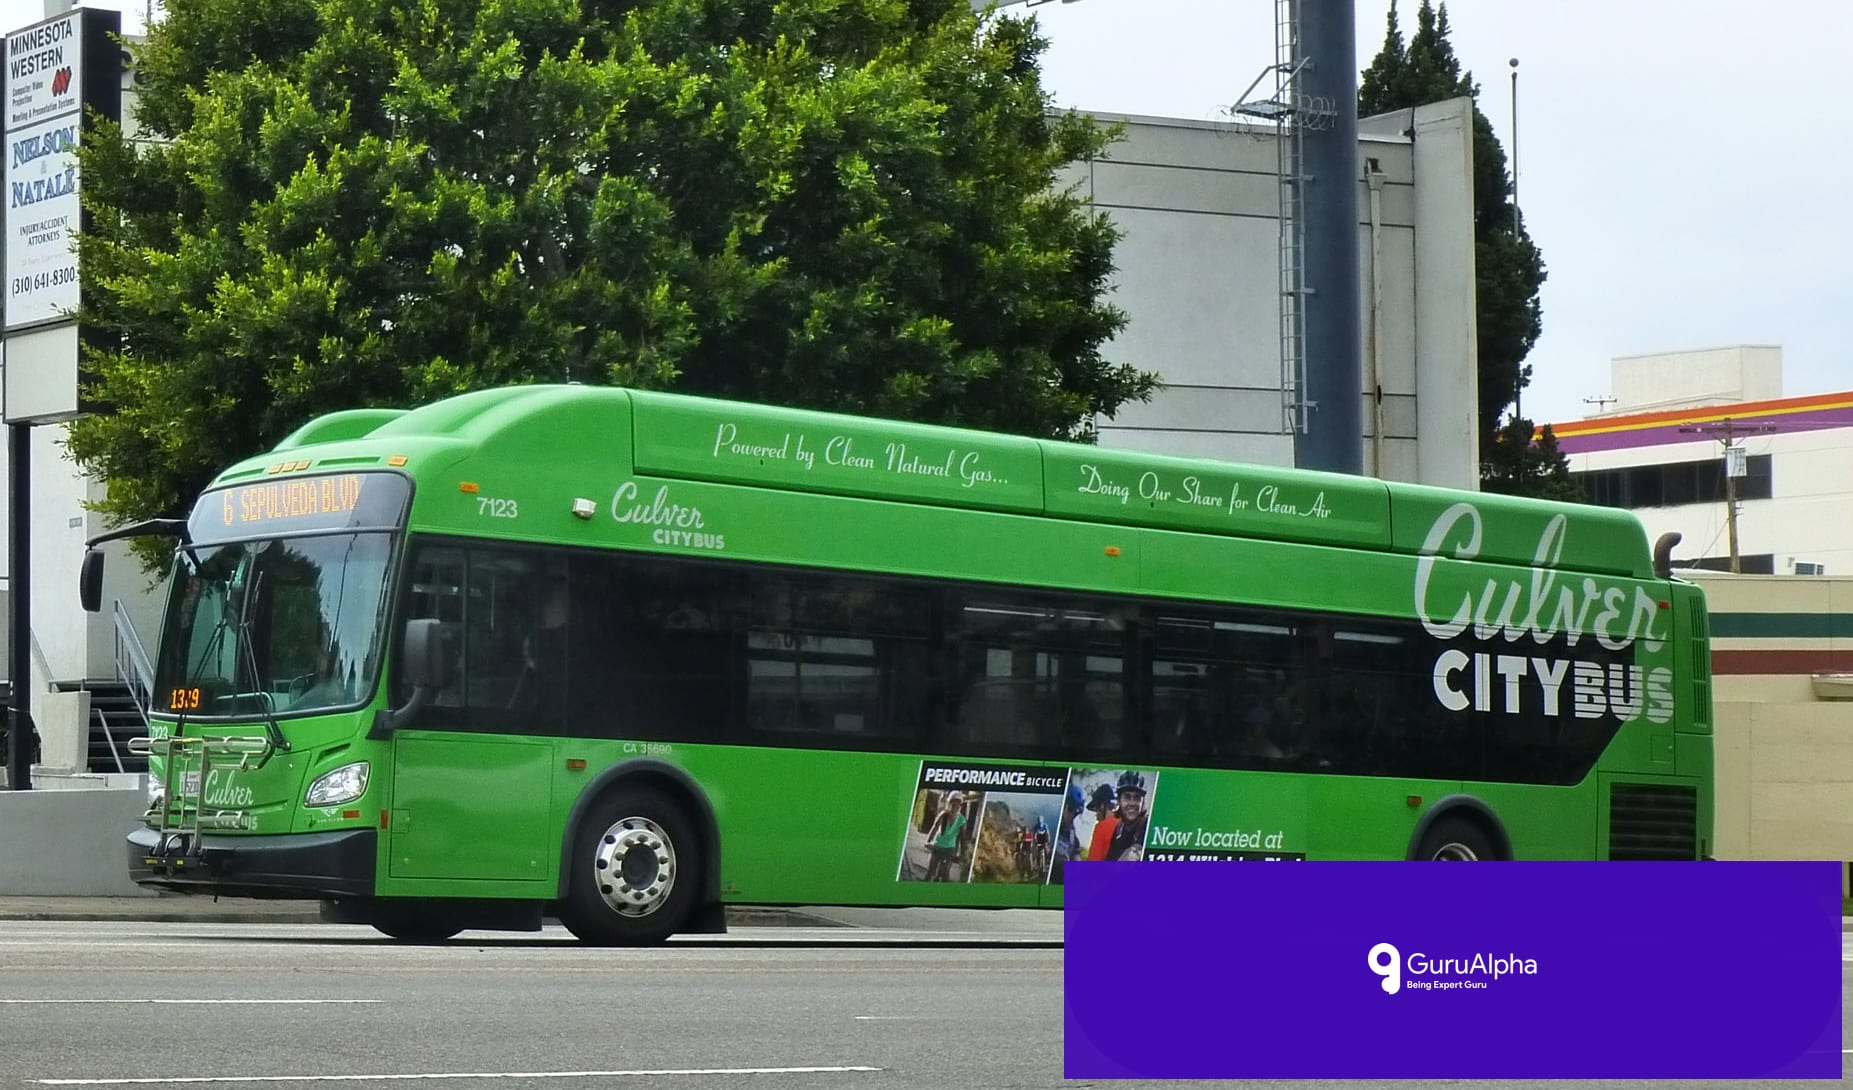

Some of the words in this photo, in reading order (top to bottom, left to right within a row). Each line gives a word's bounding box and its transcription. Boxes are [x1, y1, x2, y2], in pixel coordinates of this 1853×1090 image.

[11, 19, 73, 57] MINNESOTA
[11, 46, 63, 80] WESTERN
[13, 125, 75, 169] NELSON
[12, 167, 75, 208] NATALE
[28, 231, 60, 246] ATTORNEYS
[12, 276, 32, 298] (310)
[34, 266, 75, 290] 641-8300
[713, 423, 790, 457] Powered
[796, 435, 814, 470] by
[825, 436, 874, 468] Clean
[886, 442, 954, 477] Natural
[223, 489, 234, 526] 6
[241, 480, 317, 522] SEPULVEDA
[322, 475, 359, 512] BLVD
[477, 497, 518, 518] 7123
[611, 482, 704, 528] Culver
[1078, 464, 1129, 504] Doing
[1139, 471, 1171, 501] Our
[1176, 476, 1222, 507] Share
[1228, 482, 1249, 515] for
[1256, 485, 1297, 516] Clean
[1299, 491, 1331, 519] Air
[653, 529, 725, 549] CITYBUS
[1414, 502, 1667, 653] Culver
[1433, 650, 1674, 724] CITYBUS
[623, 743, 637, 753] CA
[204, 769, 254, 805] Culver
[925, 768, 1026, 786] PERFORMANCE
[1026, 776, 1063, 788] BICYCLE
[1151, 826, 1192, 847] Now
[1194, 828, 1261, 849] located
[1264, 830, 1283, 849] at
